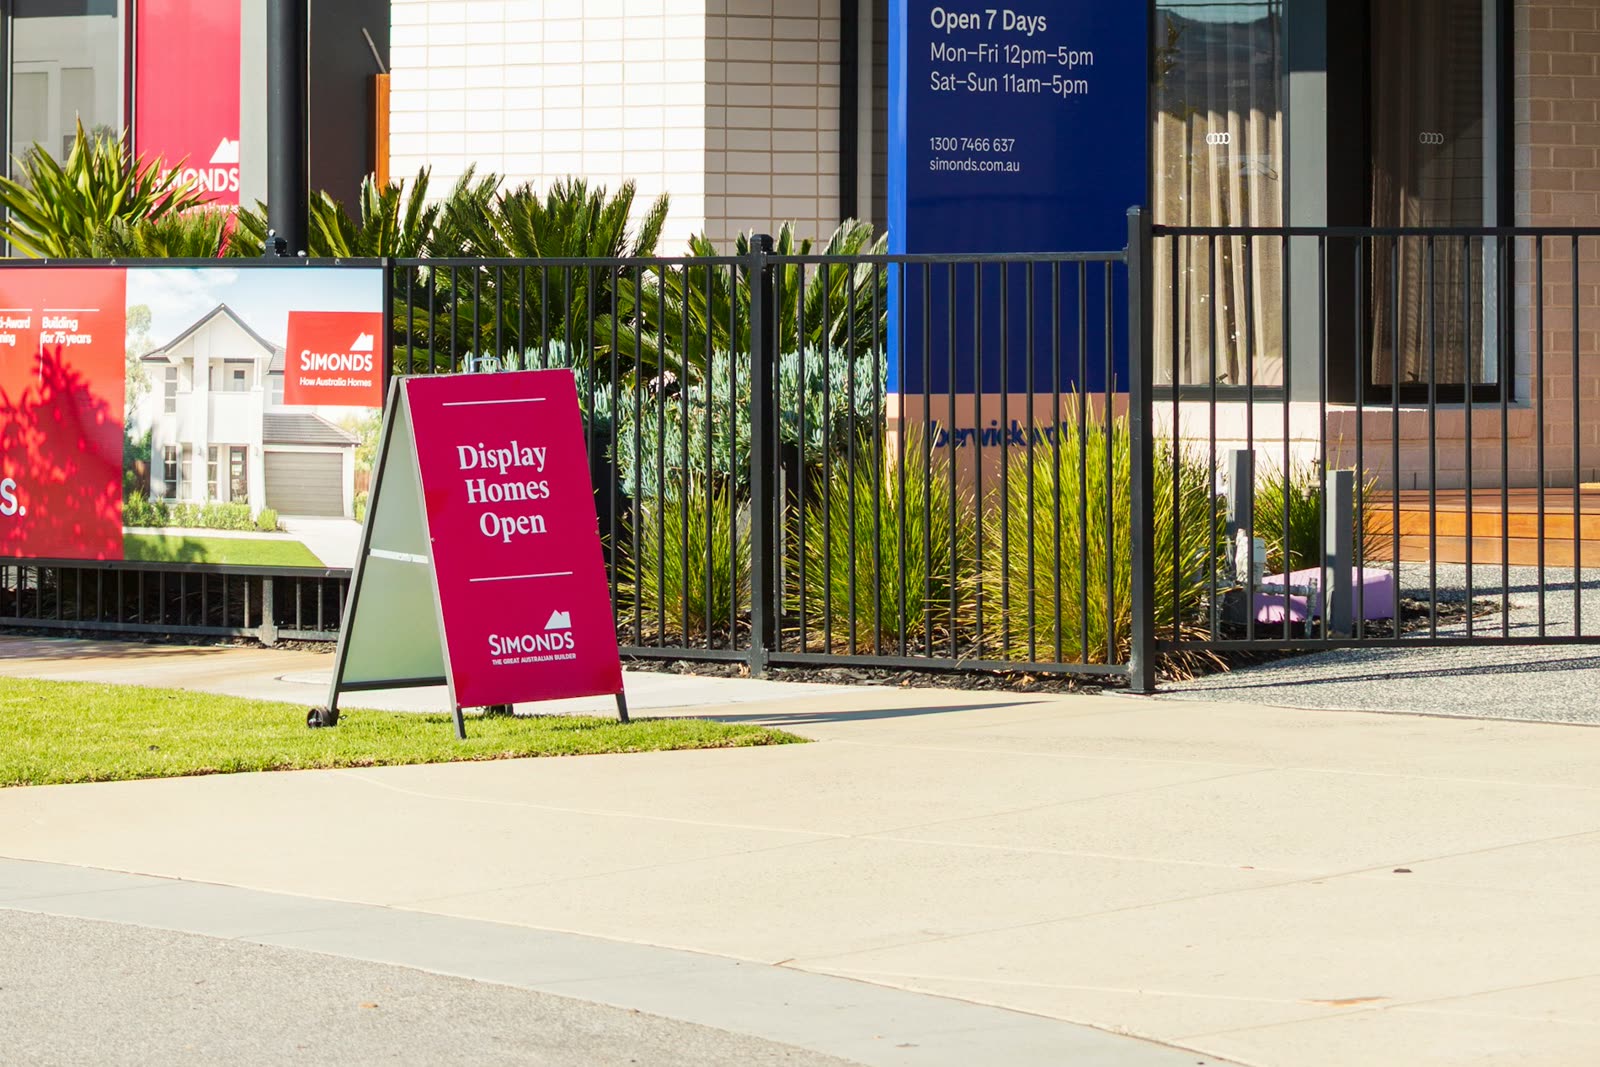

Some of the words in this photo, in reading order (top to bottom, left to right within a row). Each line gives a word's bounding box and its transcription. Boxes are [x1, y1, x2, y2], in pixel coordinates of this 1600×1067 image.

[930, 7, 981, 34] Open
[985, 9, 998, 30] 7
[1002, 9, 1047, 36] Days
[929, 137, 958, 151] 1300
[960, 138, 990, 151] 7466
[993, 138, 1015, 152] 637
[929, 157, 1020, 172] simonds.com.au
[42, 316, 79, 332] Building
[42, 331, 55, 344] for
[55, 331, 66, 344] 75
[66, 334, 92, 347] years
[300, 350, 373, 372] SIMONDS
[299, 377, 316, 387] How
[315, 377, 347, 387] Australia
[347, 378, 372, 388] Homes
[456, 440, 547, 475] Display
[465, 478, 550, 504] Homes
[479, 512, 547, 543] Open
[488, 631, 575, 656] SIMONDS
[503, 657, 520, 665] GREAT
[520, 655, 554, 664] AUSTRALIAN
[554, 653, 576, 661] BUILDER
